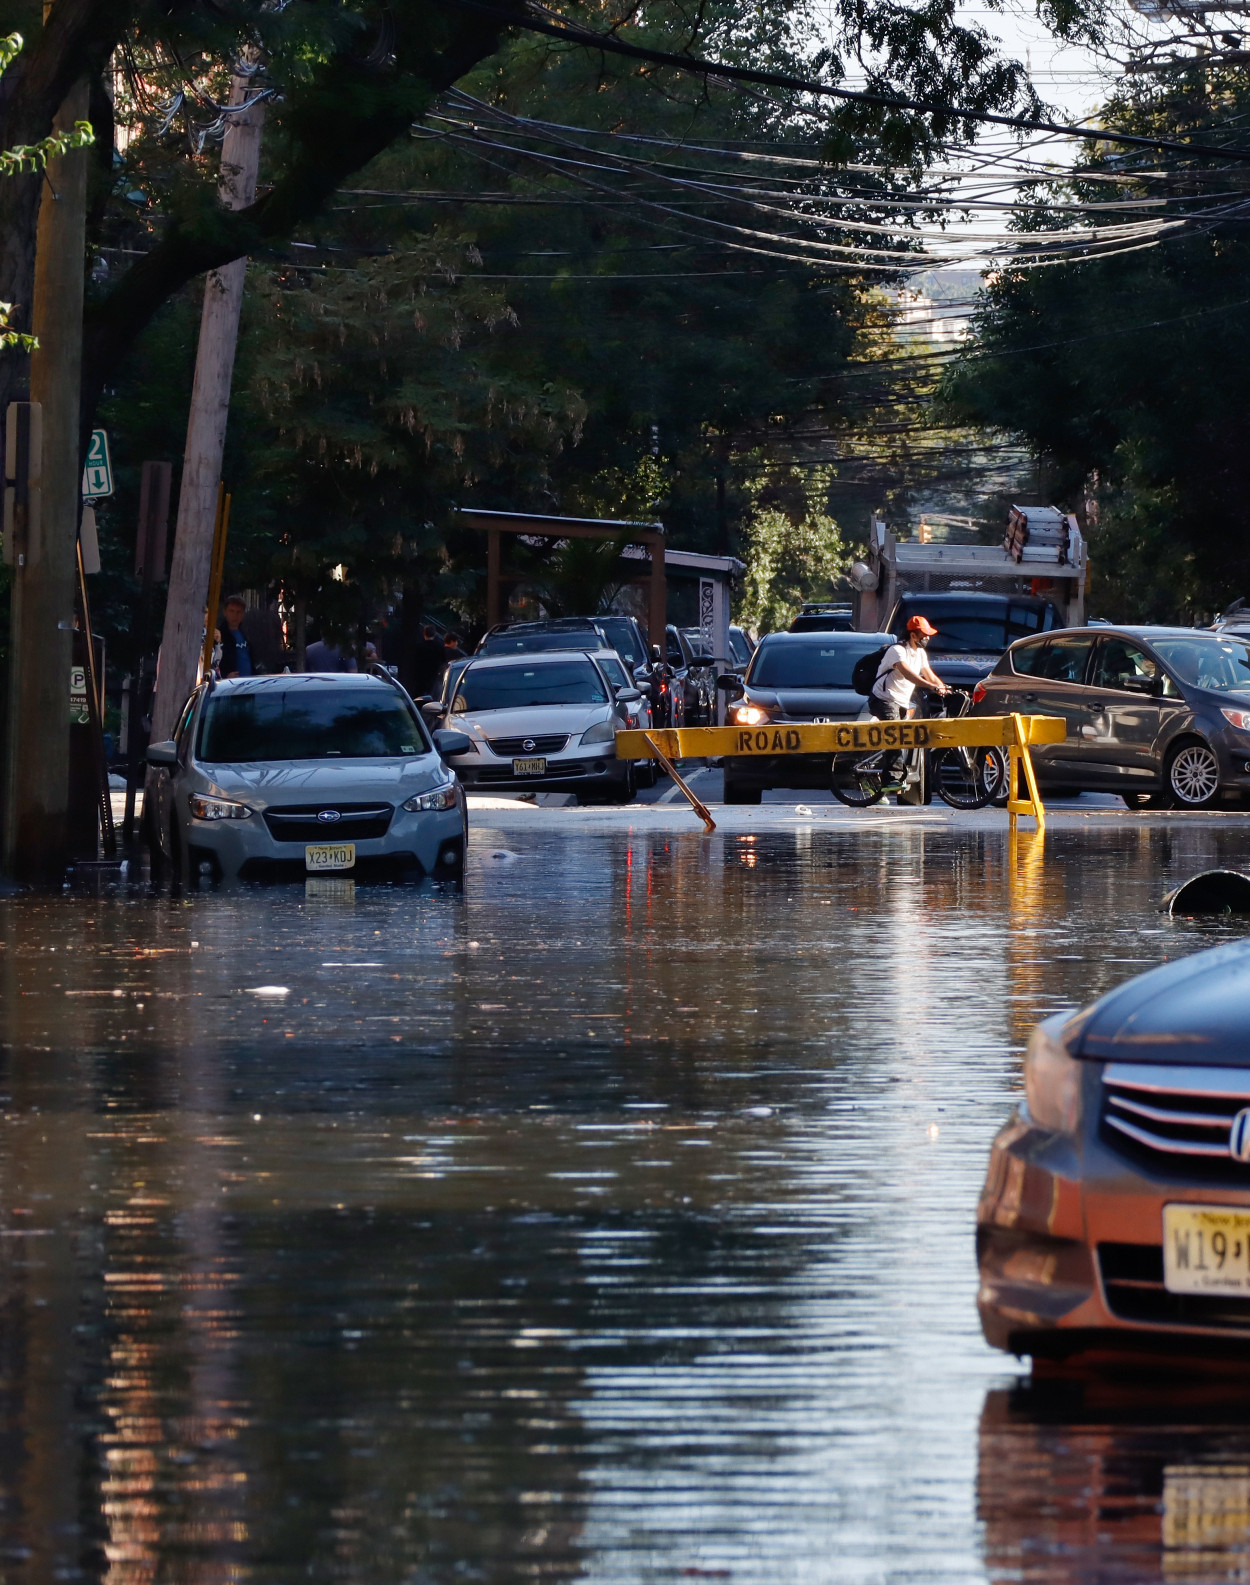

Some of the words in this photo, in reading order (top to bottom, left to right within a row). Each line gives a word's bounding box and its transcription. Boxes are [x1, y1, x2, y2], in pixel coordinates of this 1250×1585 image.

[88, 434, 102, 460] 2
[74, 674, 84, 685] P
[737, 729, 801, 751] ROAD
[836, 724, 930, 748] CLOSED
